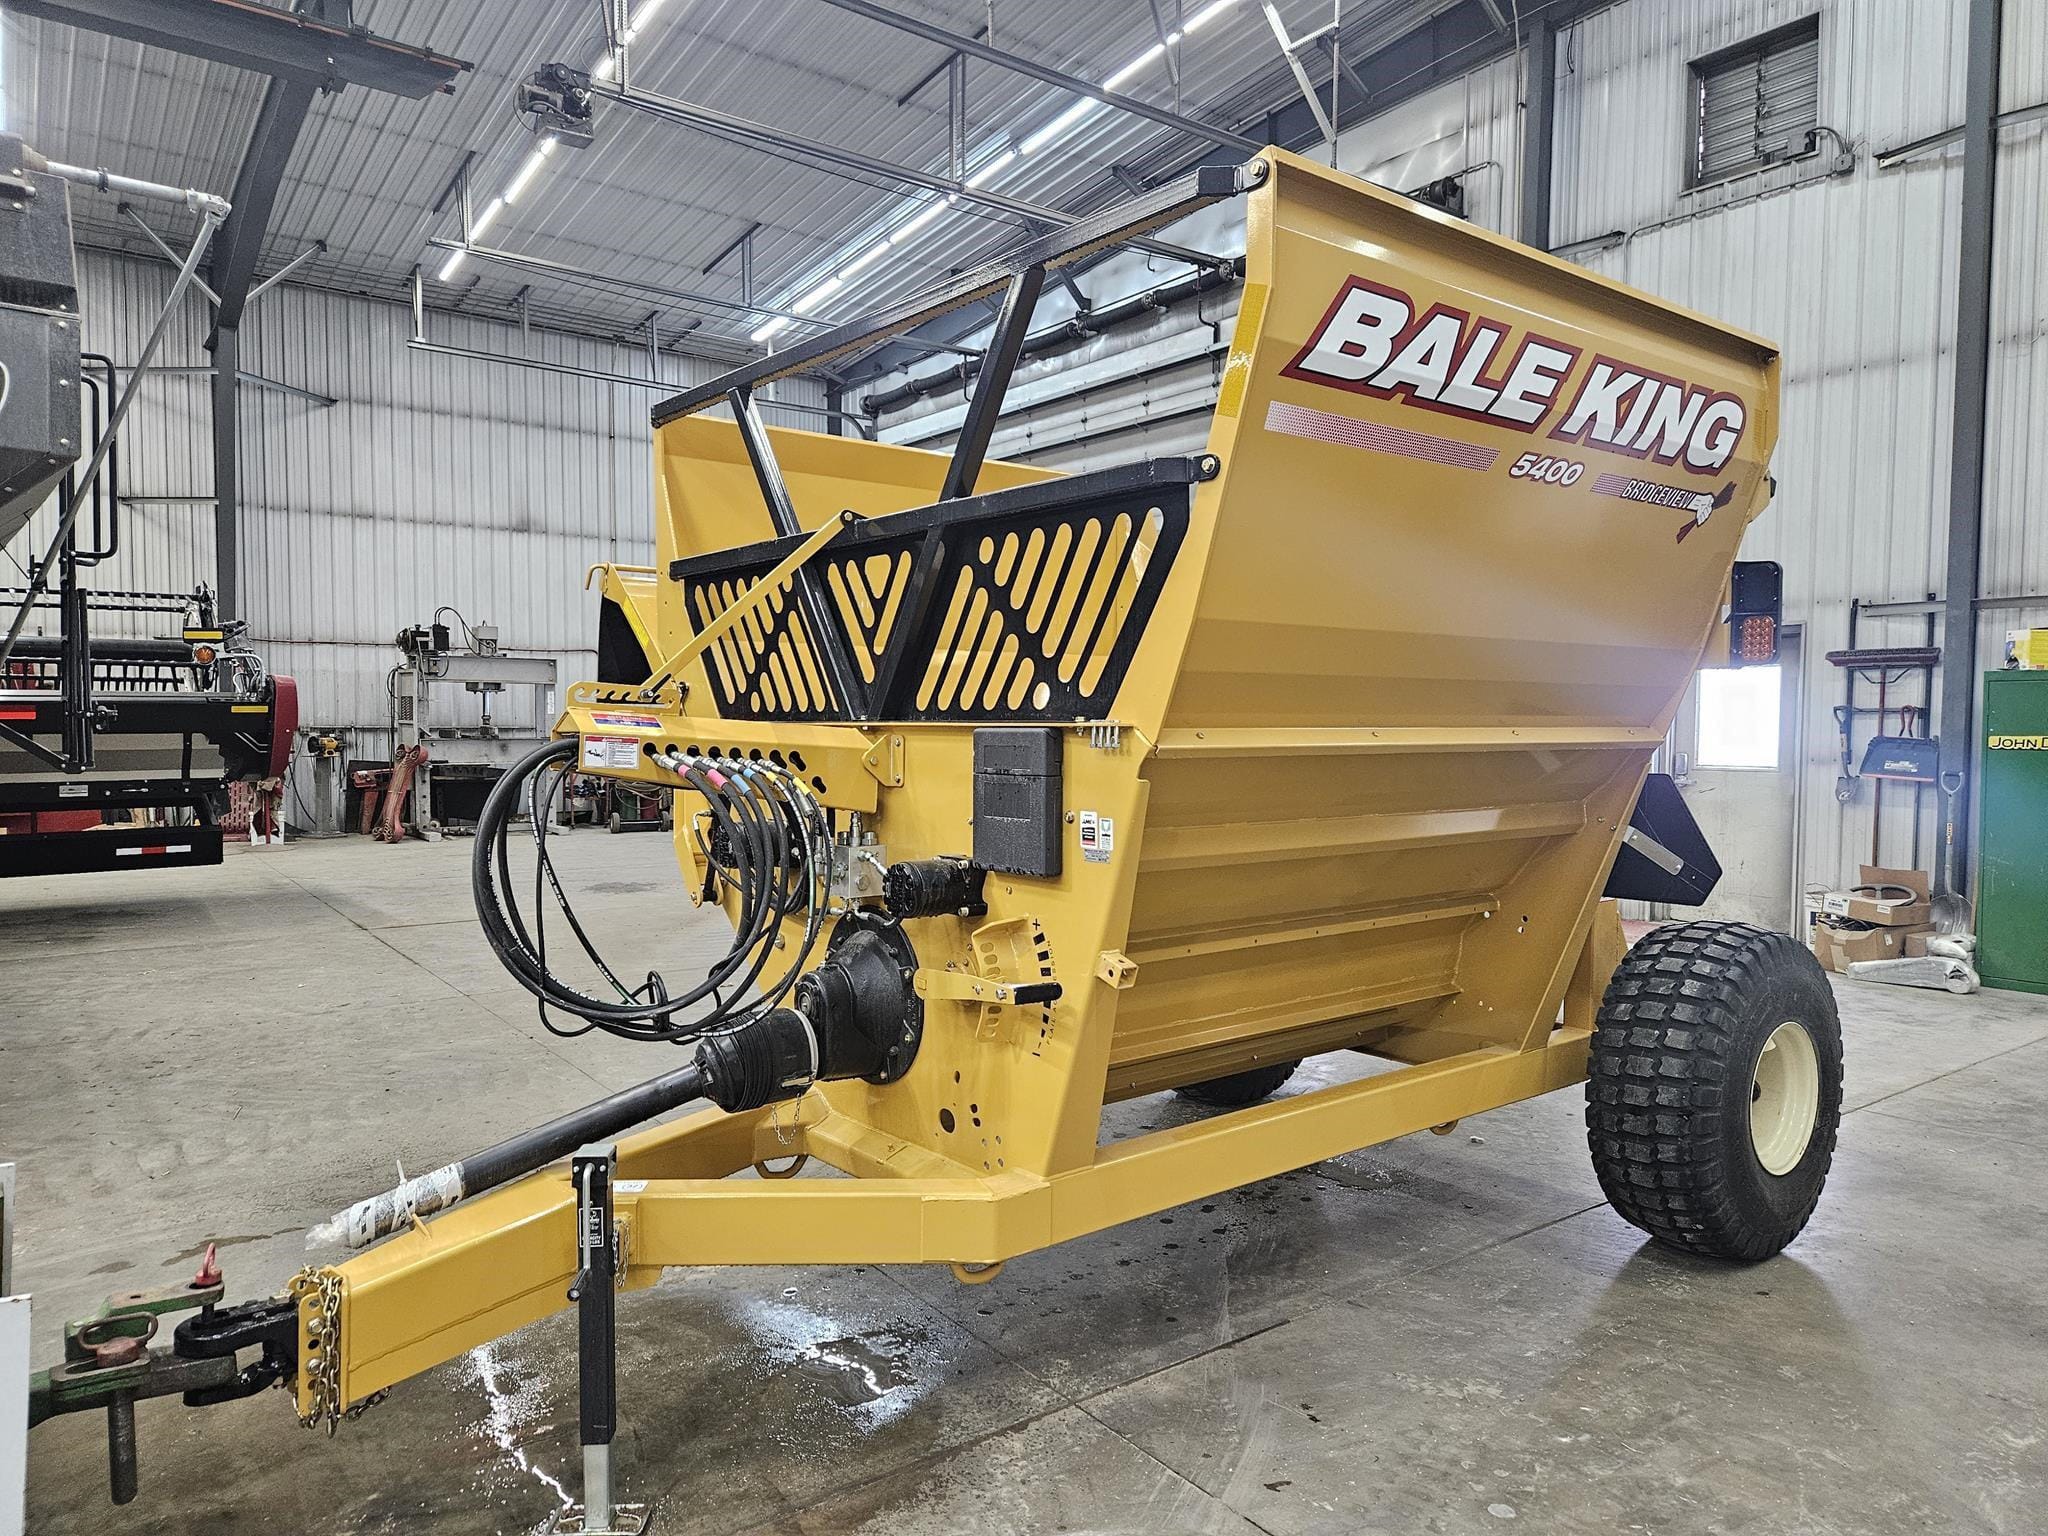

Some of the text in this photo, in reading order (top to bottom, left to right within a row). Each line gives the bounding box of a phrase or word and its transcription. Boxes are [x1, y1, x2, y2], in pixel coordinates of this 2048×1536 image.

[1296, 285, 1746, 470] BALE KING
[1510, 453, 1585, 486] 5400
[1621, 479, 1697, 511] BRIDGEVIEW
[1991, 737, 2037, 748] JOHN
